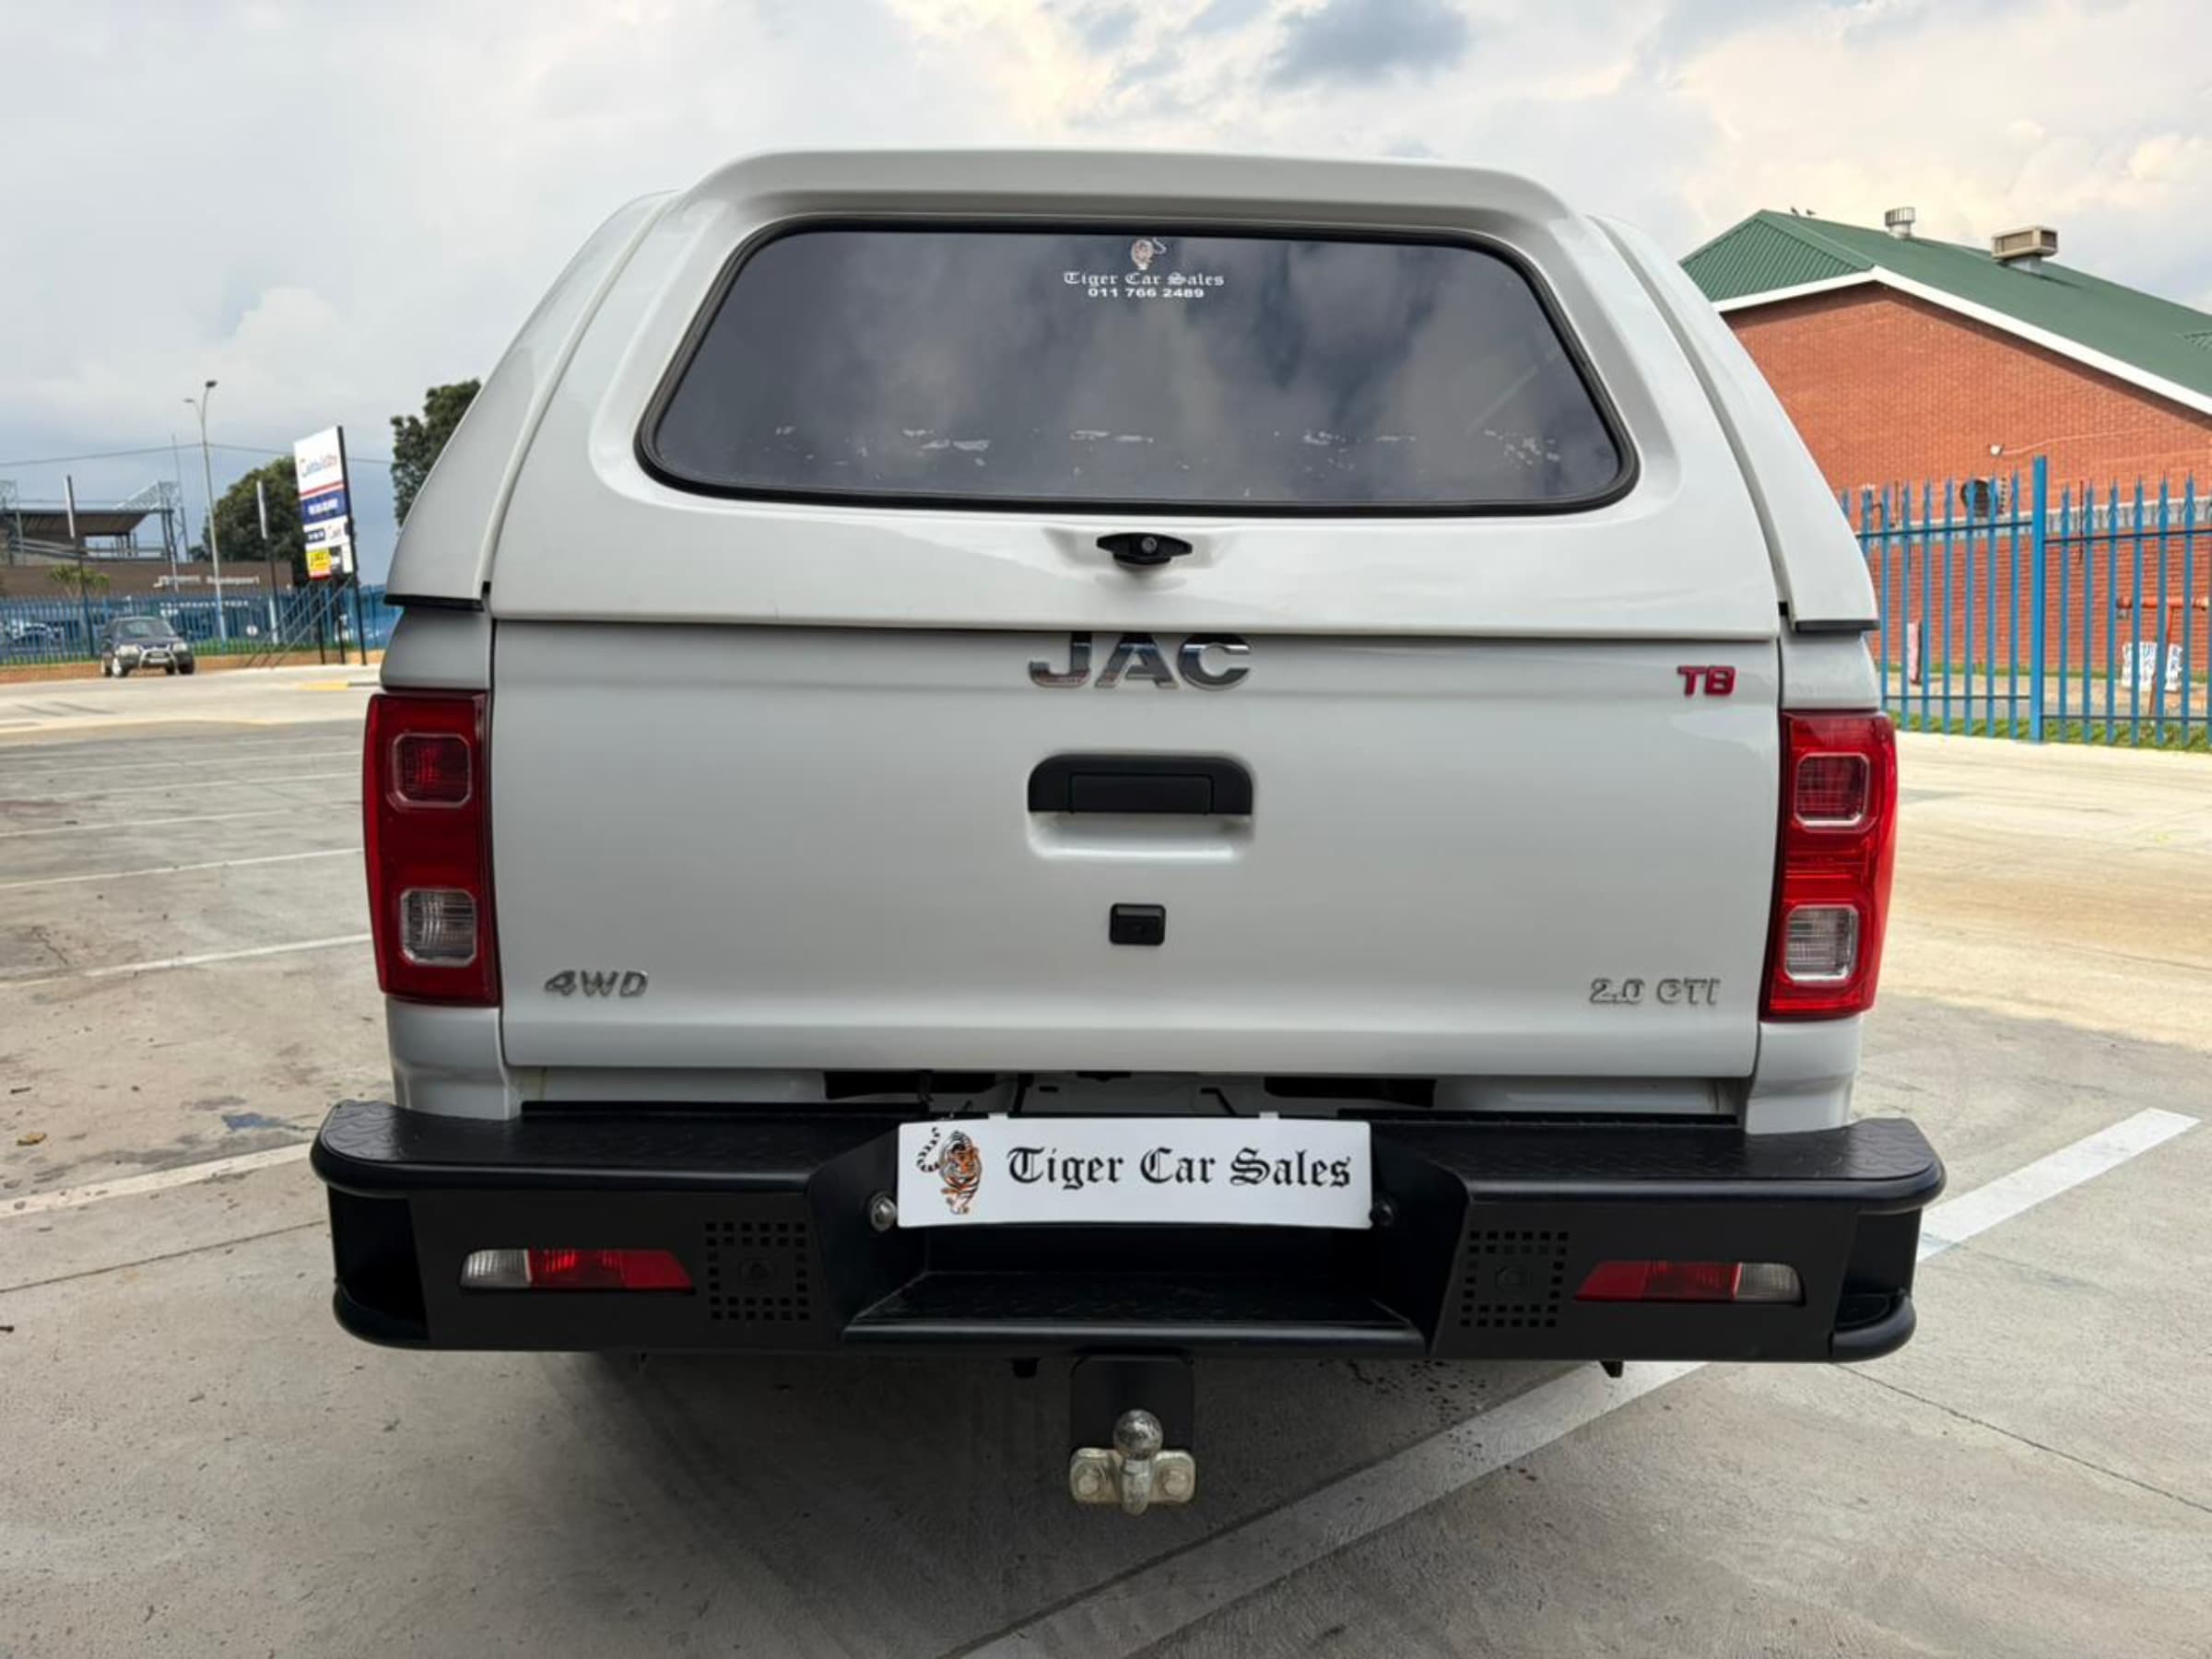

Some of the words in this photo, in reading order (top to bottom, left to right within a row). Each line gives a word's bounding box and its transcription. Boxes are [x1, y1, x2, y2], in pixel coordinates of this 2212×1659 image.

[1063, 271, 1117, 287] Tiger
[1124, 271, 1161, 286] Car
[1167, 271, 1225, 287] Sales
[1088, 288, 1118, 298] 011
[1124, 288, 1157, 298] 766
[1162, 288, 1205, 298] 2489
[1028, 632, 1252, 691] JAC
[544, 970, 649, 997] 4WD
[1589, 978, 1645, 1005] 2.0
[1006, 1146, 1124, 1190] Tiger
[1139, 1147, 1217, 1185] Car
[1230, 1147, 1352, 1189] Sales
